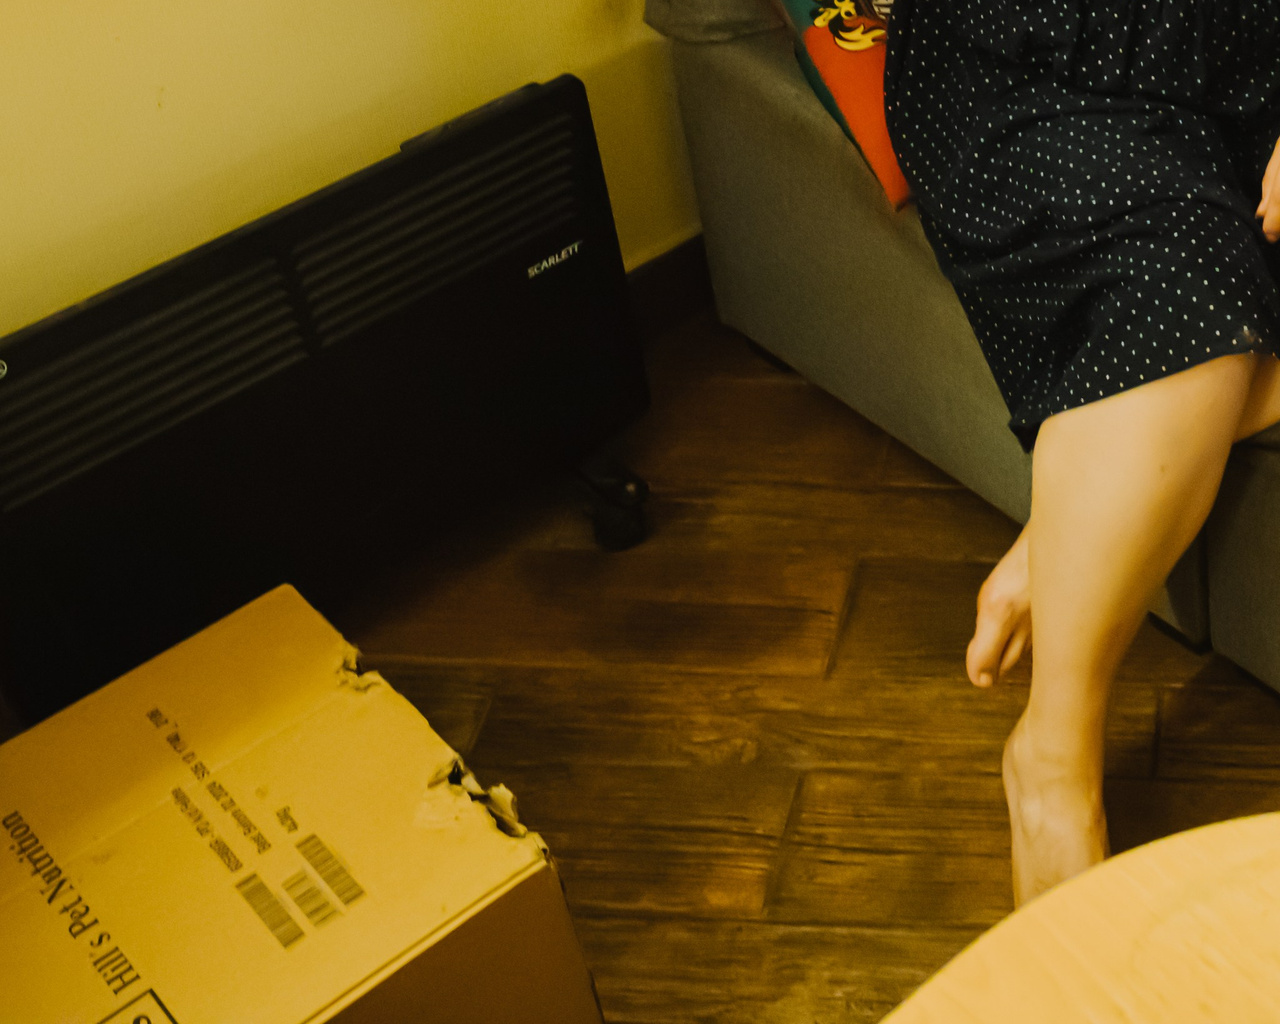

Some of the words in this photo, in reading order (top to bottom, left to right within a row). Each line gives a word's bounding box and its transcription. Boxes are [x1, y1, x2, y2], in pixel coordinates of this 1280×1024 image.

[527, 241, 583, 279] SCARLETT
[2, 810, 74, 904] Nutrition
[59, 895, 99, 939] Pet
[89, 931, 141, 996] Hill's
